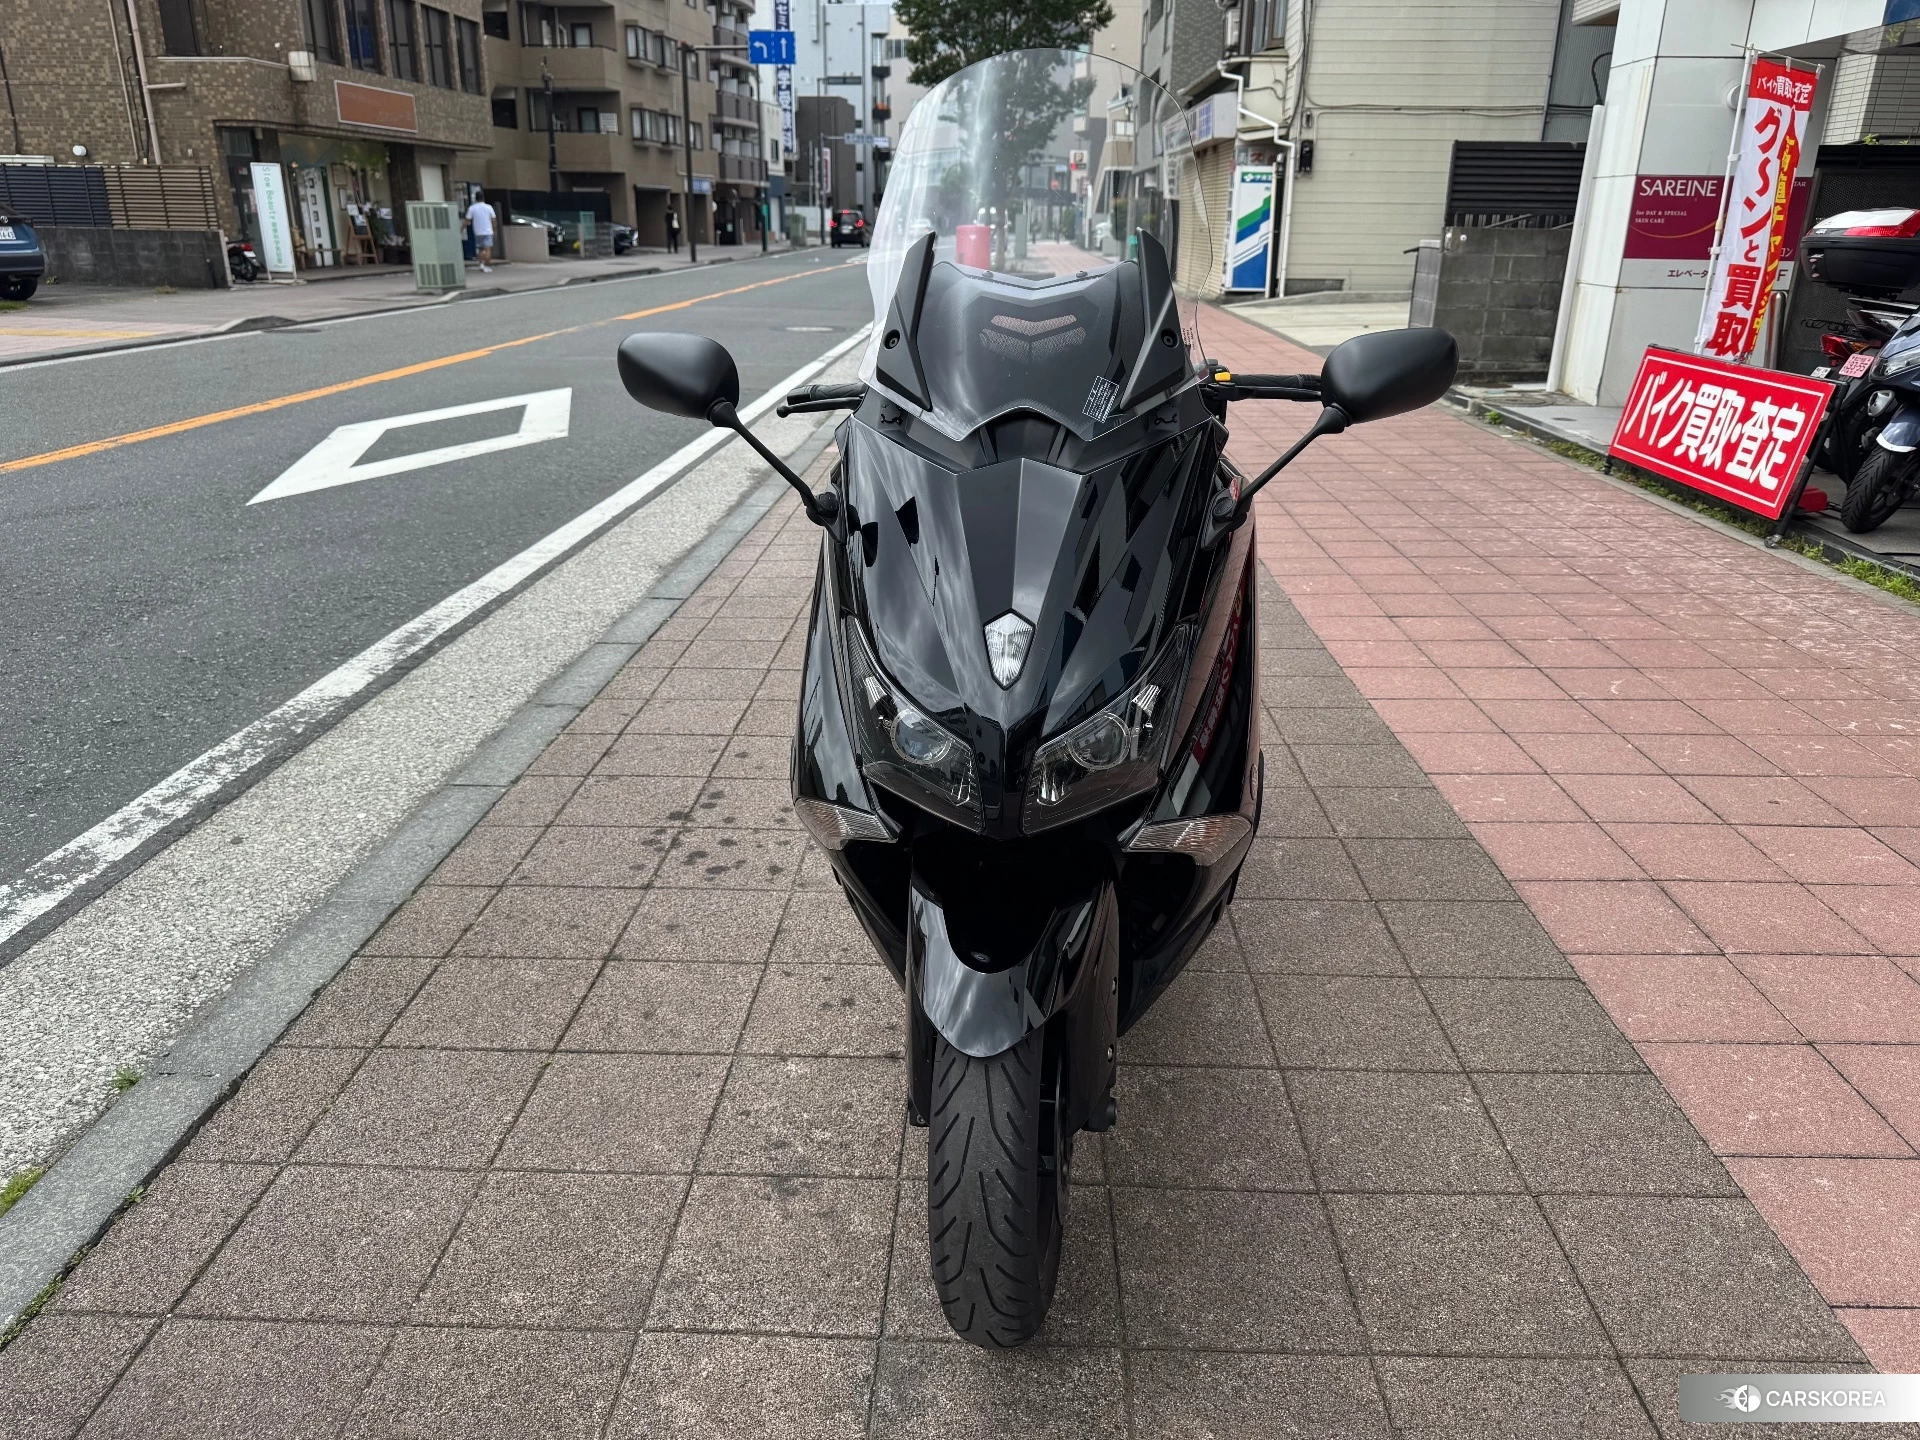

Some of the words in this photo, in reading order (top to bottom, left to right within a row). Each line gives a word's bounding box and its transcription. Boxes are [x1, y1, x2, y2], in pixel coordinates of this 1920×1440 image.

[1639, 179, 1718, 197] SAREINE
[1666, 269, 1715, 279] エレベータ
[1624, 371, 1806, 491] バイク買取・査定
